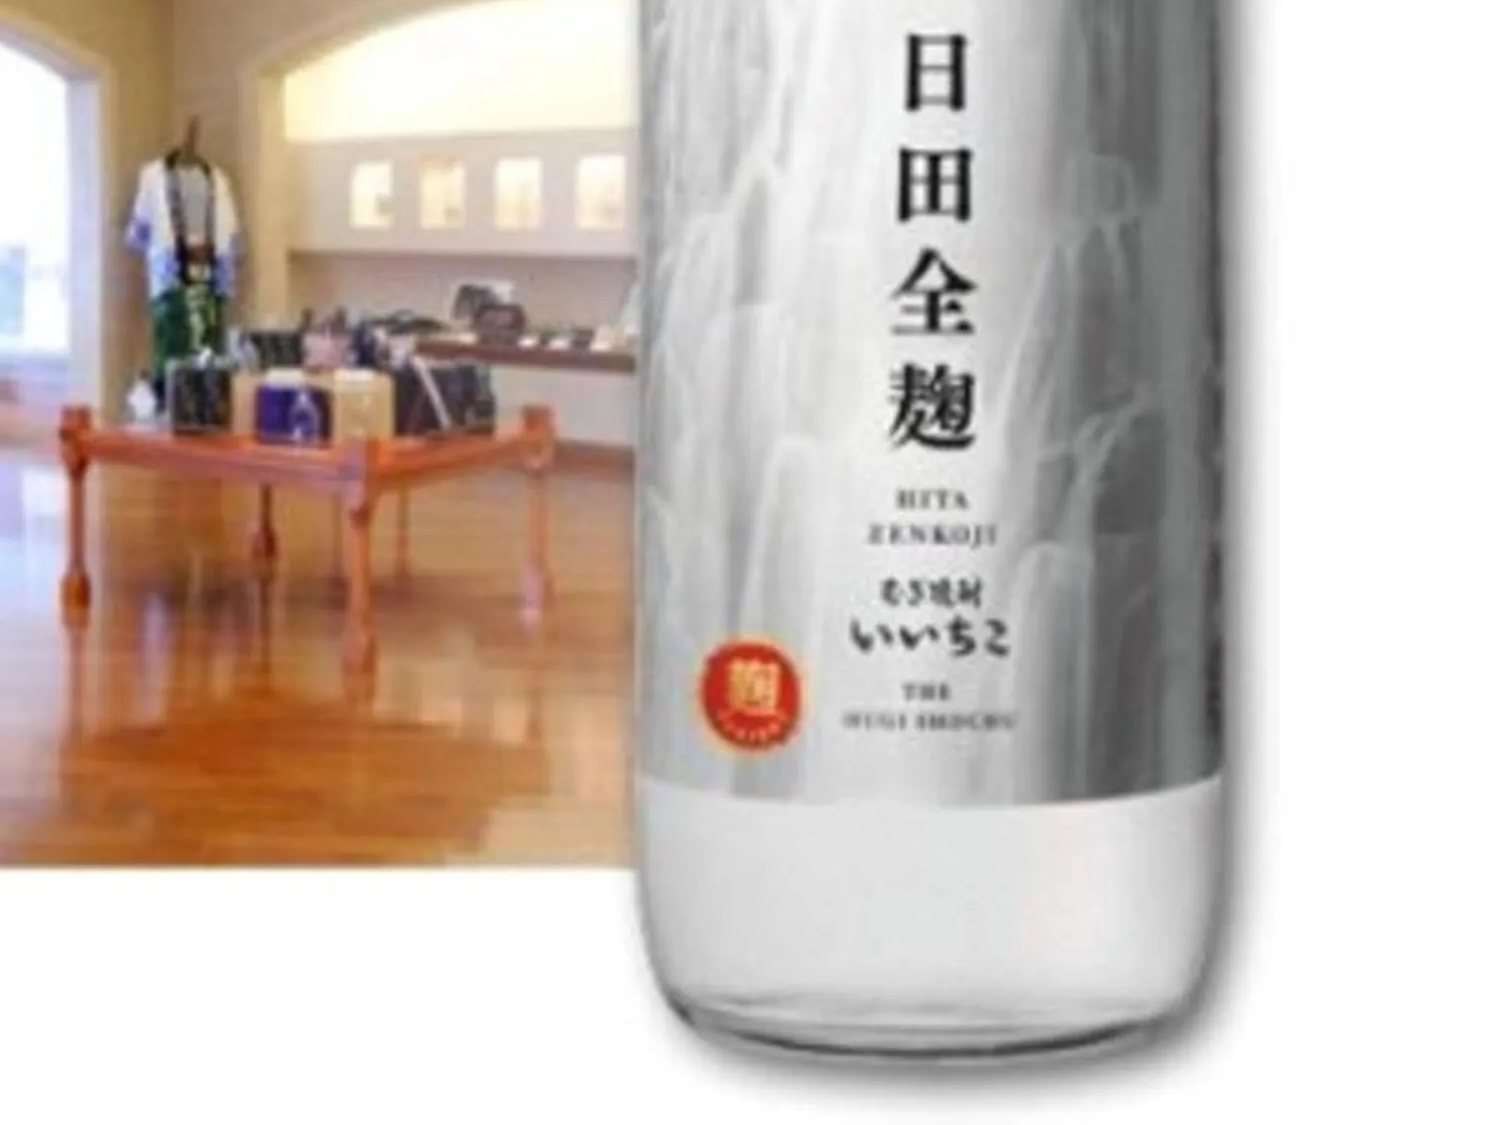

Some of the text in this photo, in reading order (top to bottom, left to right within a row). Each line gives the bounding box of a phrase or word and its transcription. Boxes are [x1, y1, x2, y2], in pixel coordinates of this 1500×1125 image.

[888, 32, 978, 451] 日田全麹
[895, 488, 970, 511] HITA
[866, 523, 998, 551] ZENKOJI
[849, 615, 1012, 659] いいちこ
[901, 681, 952, 702] THE
